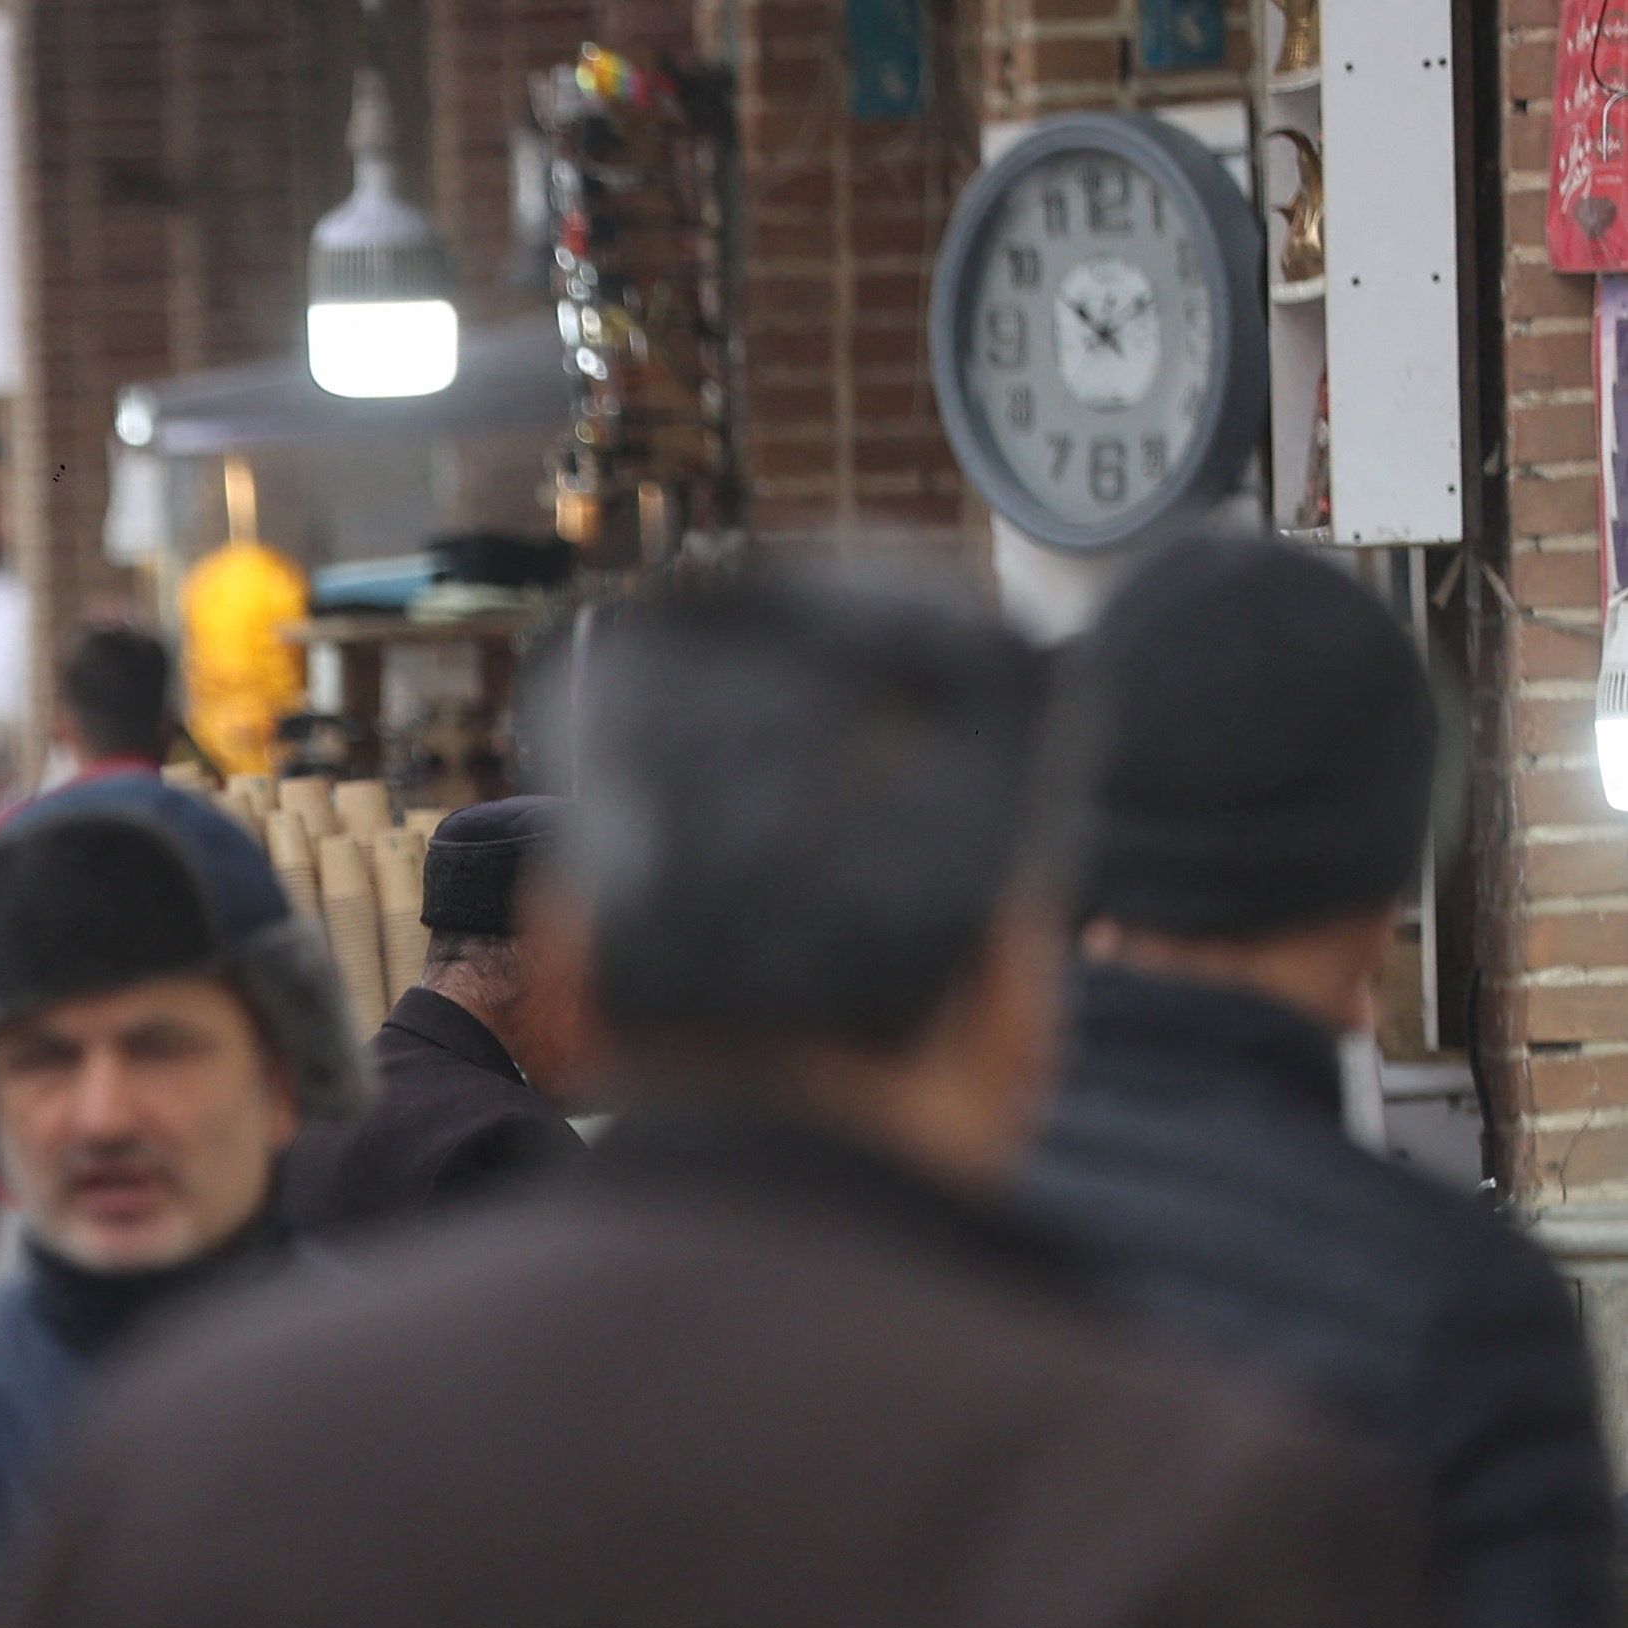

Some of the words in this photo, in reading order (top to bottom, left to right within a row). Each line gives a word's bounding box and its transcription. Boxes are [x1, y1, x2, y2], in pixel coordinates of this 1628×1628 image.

[1082, 166, 1133, 233] 12
[989, 310, 1026, 368] 9
[1046, 435, 1073, 479] 7
[1088, 438, 1127, 501] 6
